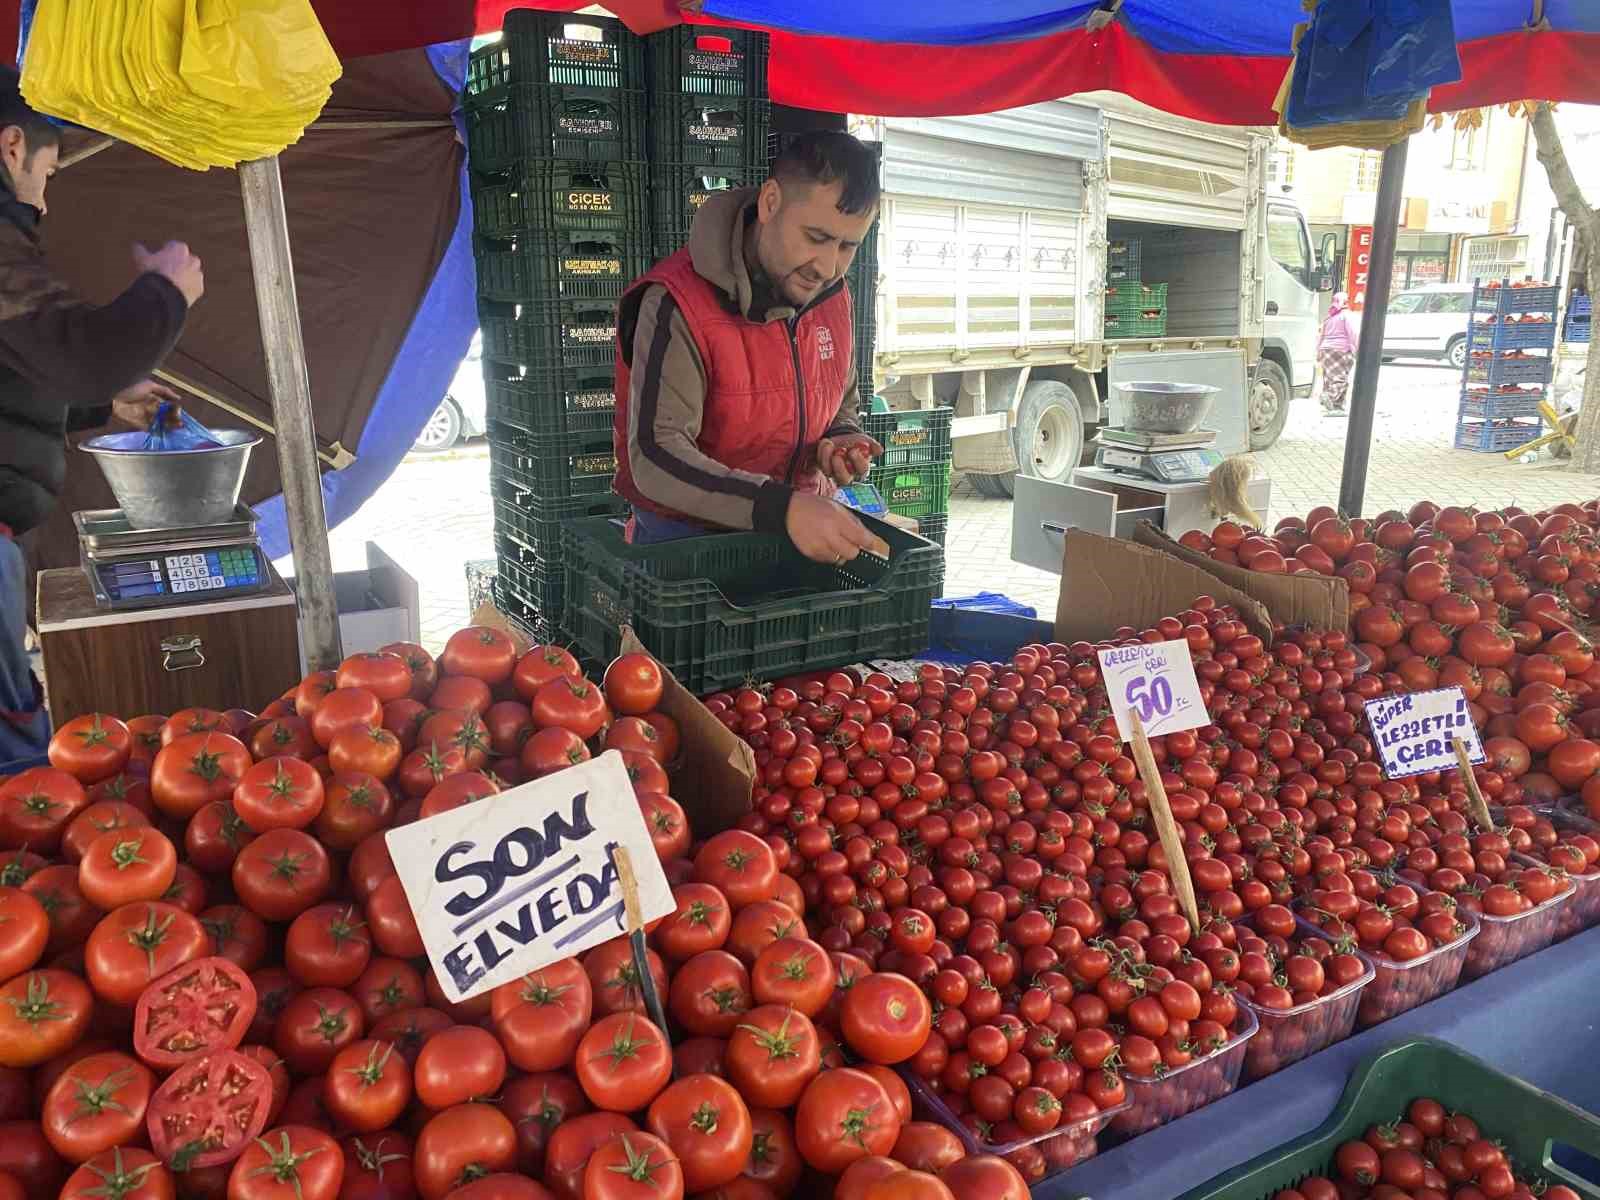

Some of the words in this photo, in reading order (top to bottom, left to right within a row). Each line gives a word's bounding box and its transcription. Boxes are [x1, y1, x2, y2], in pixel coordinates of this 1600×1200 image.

[1126, 676, 1172, 723] 50
[435, 790, 596, 917] SON
[442, 841, 625, 995] ELVEDA
